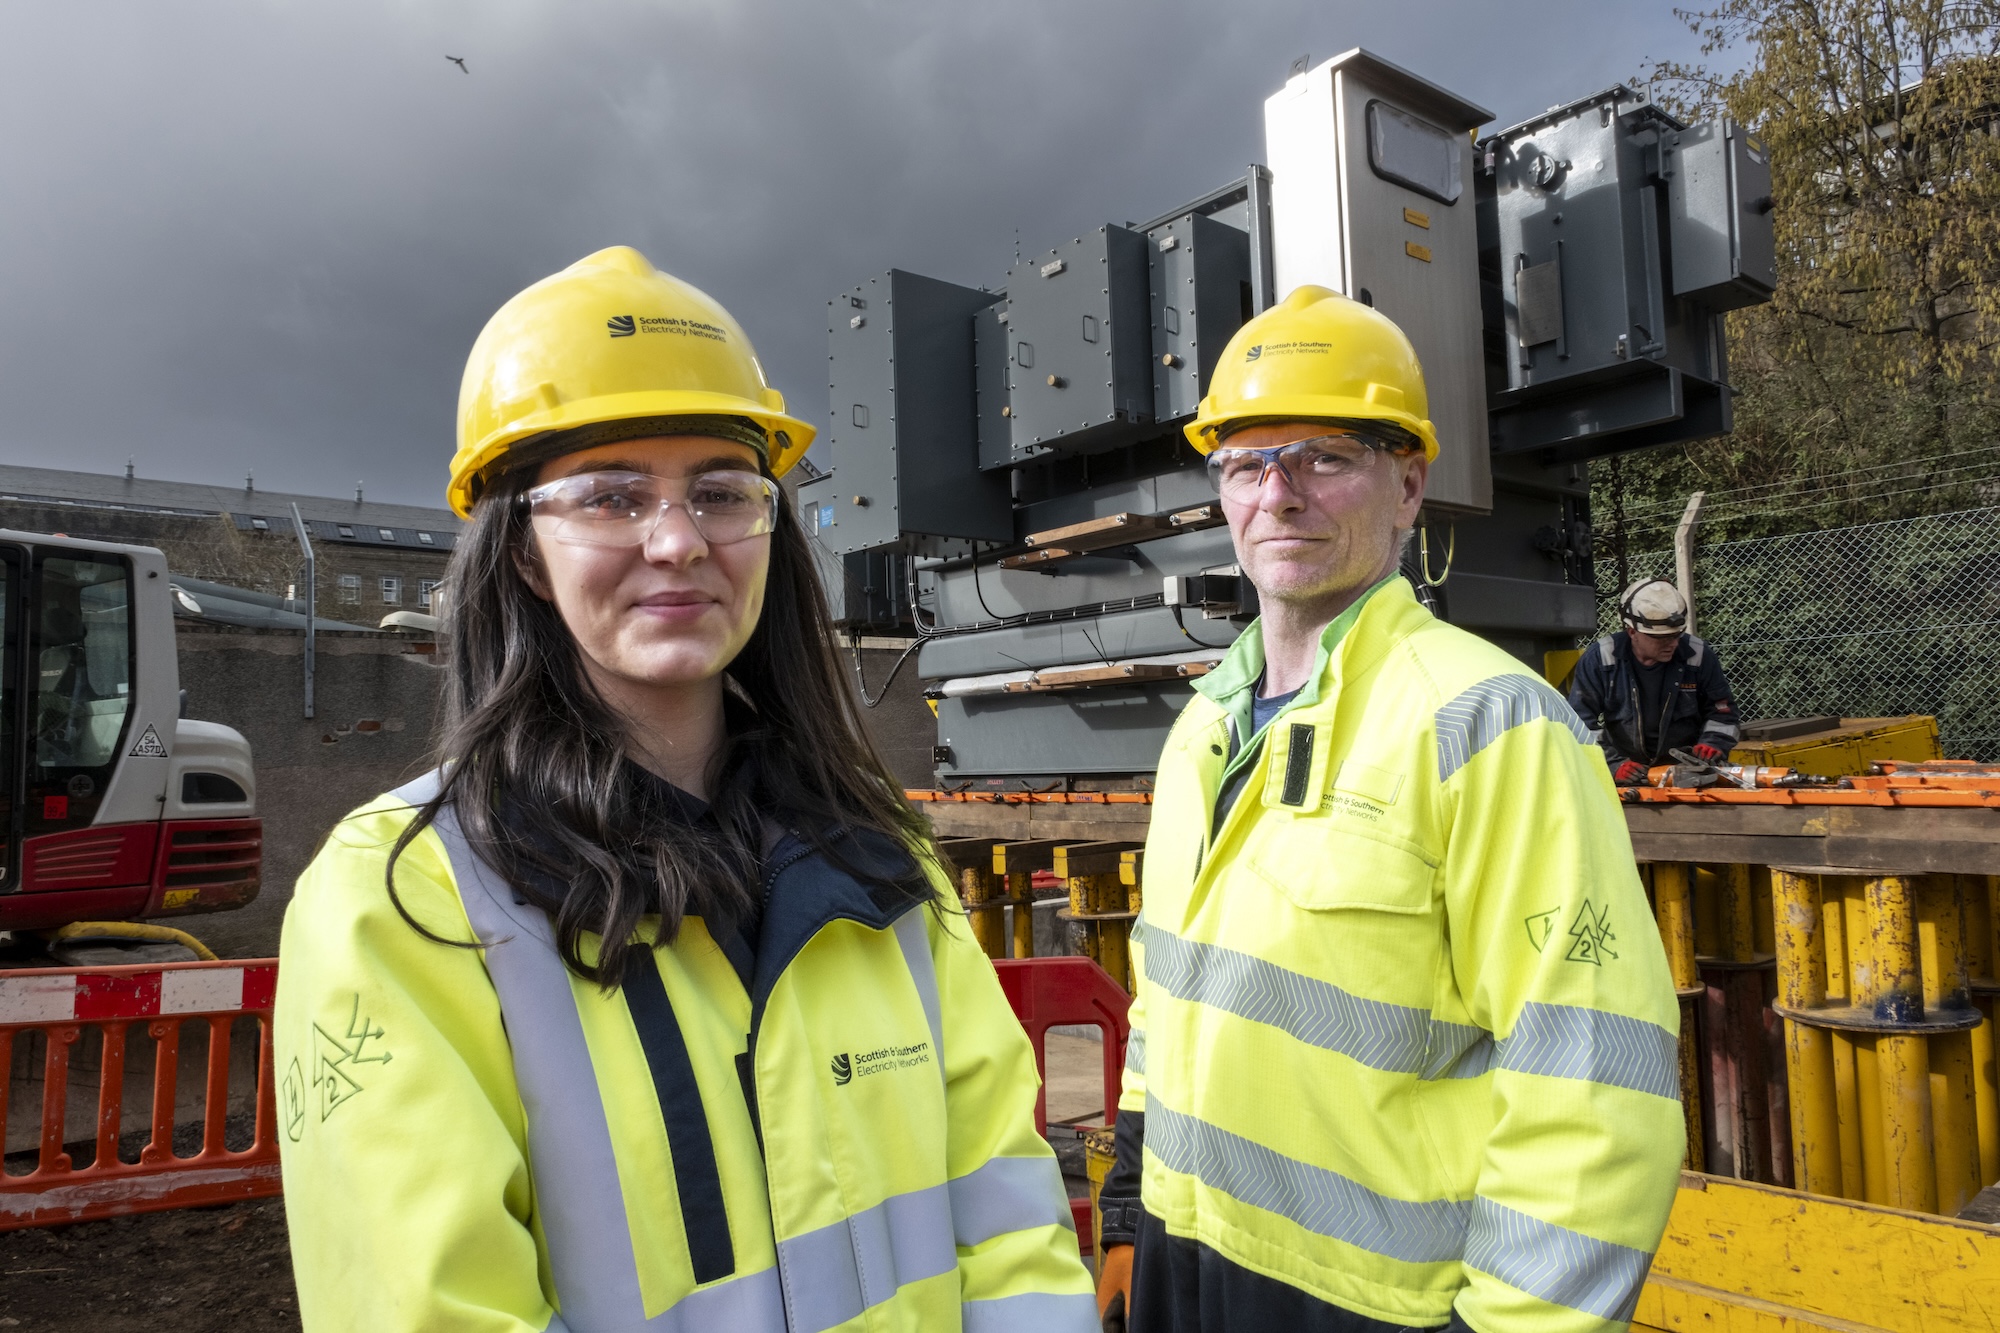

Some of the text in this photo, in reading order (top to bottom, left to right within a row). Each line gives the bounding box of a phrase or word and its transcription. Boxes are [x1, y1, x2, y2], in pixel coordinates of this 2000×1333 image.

[639, 317, 679, 326] Scottish
[689, 320, 726, 335] Southern
[641, 325, 727, 343] Electricity Networks
[1263, 348, 1294, 358] Electricity
[1265, 342, 1291, 350] Scottish
[144, 736, 155, 745] 54
[1346, 807, 1378, 822] Networks
[1350, 799, 1384, 815] Southern
[855, 1049, 890, 1064] Scottish
[857, 1060, 897, 1077] Electricity
